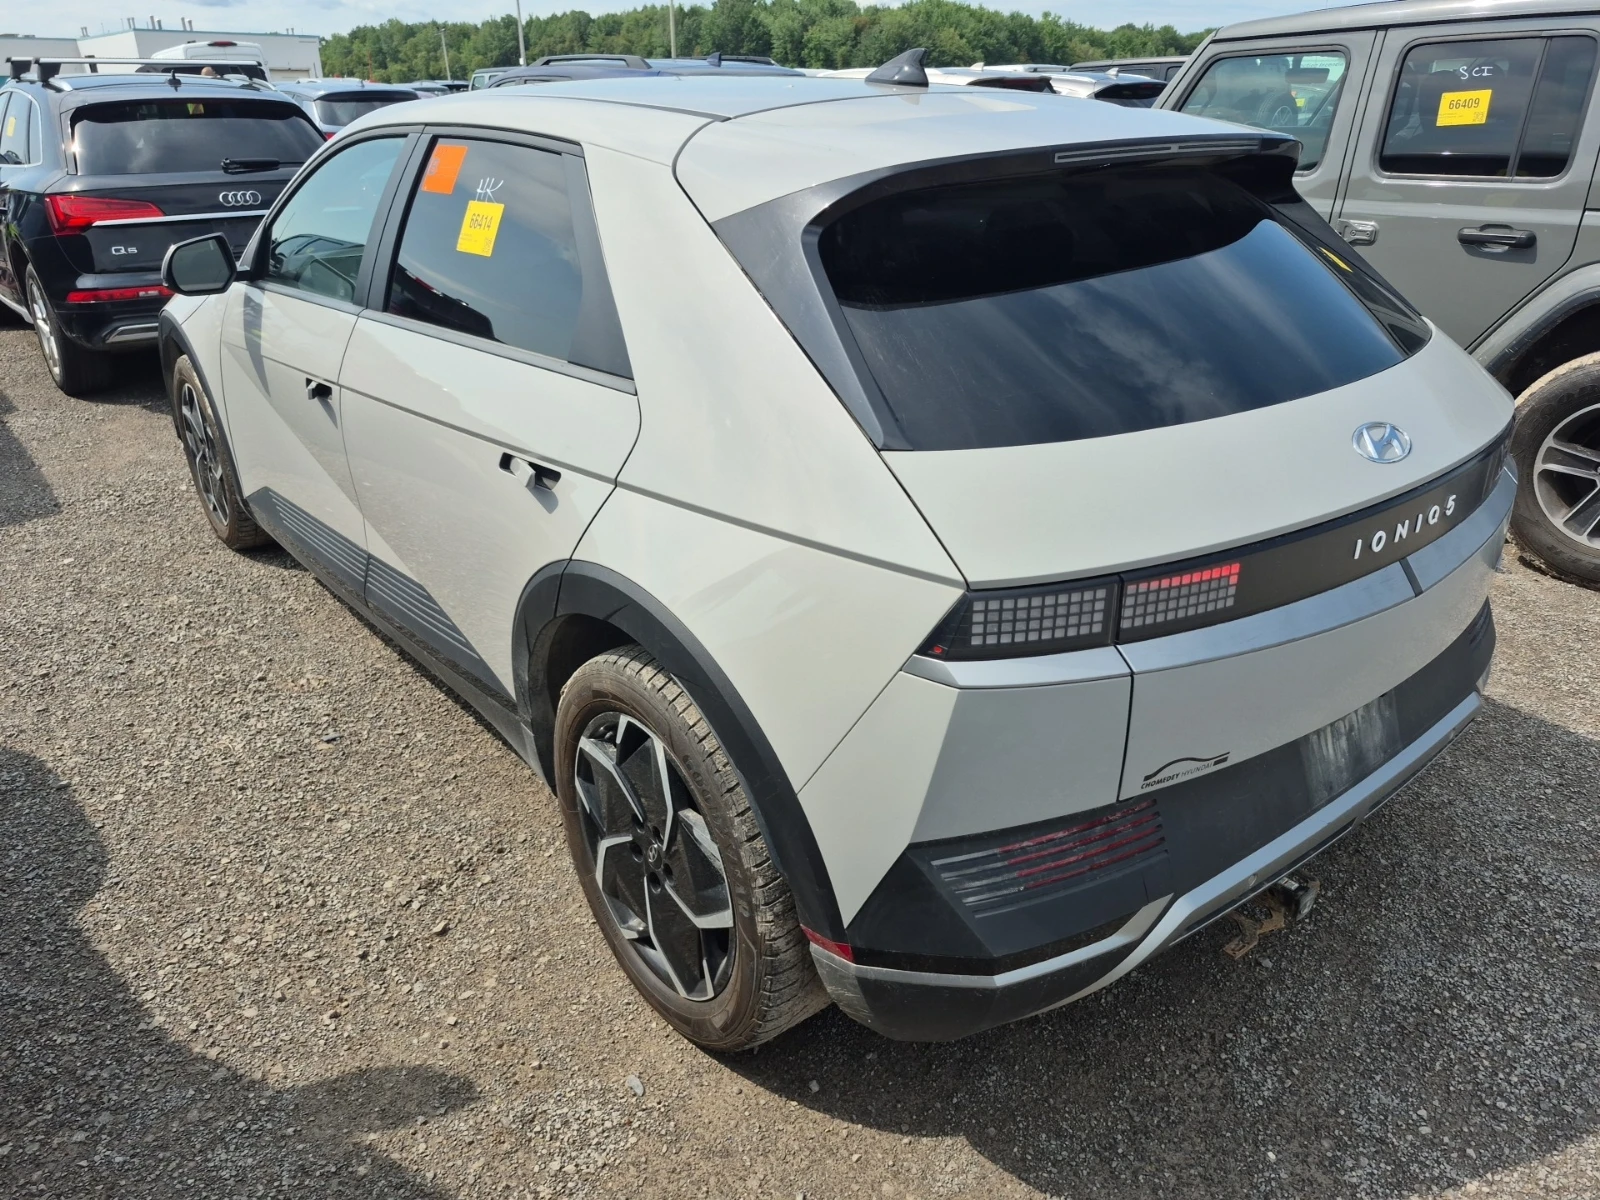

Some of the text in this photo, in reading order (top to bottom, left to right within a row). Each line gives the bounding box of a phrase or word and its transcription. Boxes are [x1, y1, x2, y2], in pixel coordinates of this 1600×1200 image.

[1459, 65, 1494, 80] SCI
[1448, 97, 1480, 110] 66409
[469, 213, 493, 231] 66414
[111, 246, 138, 255] Q5
[1140, 762, 1213, 789] CHOMEDEY HYUNDAI
